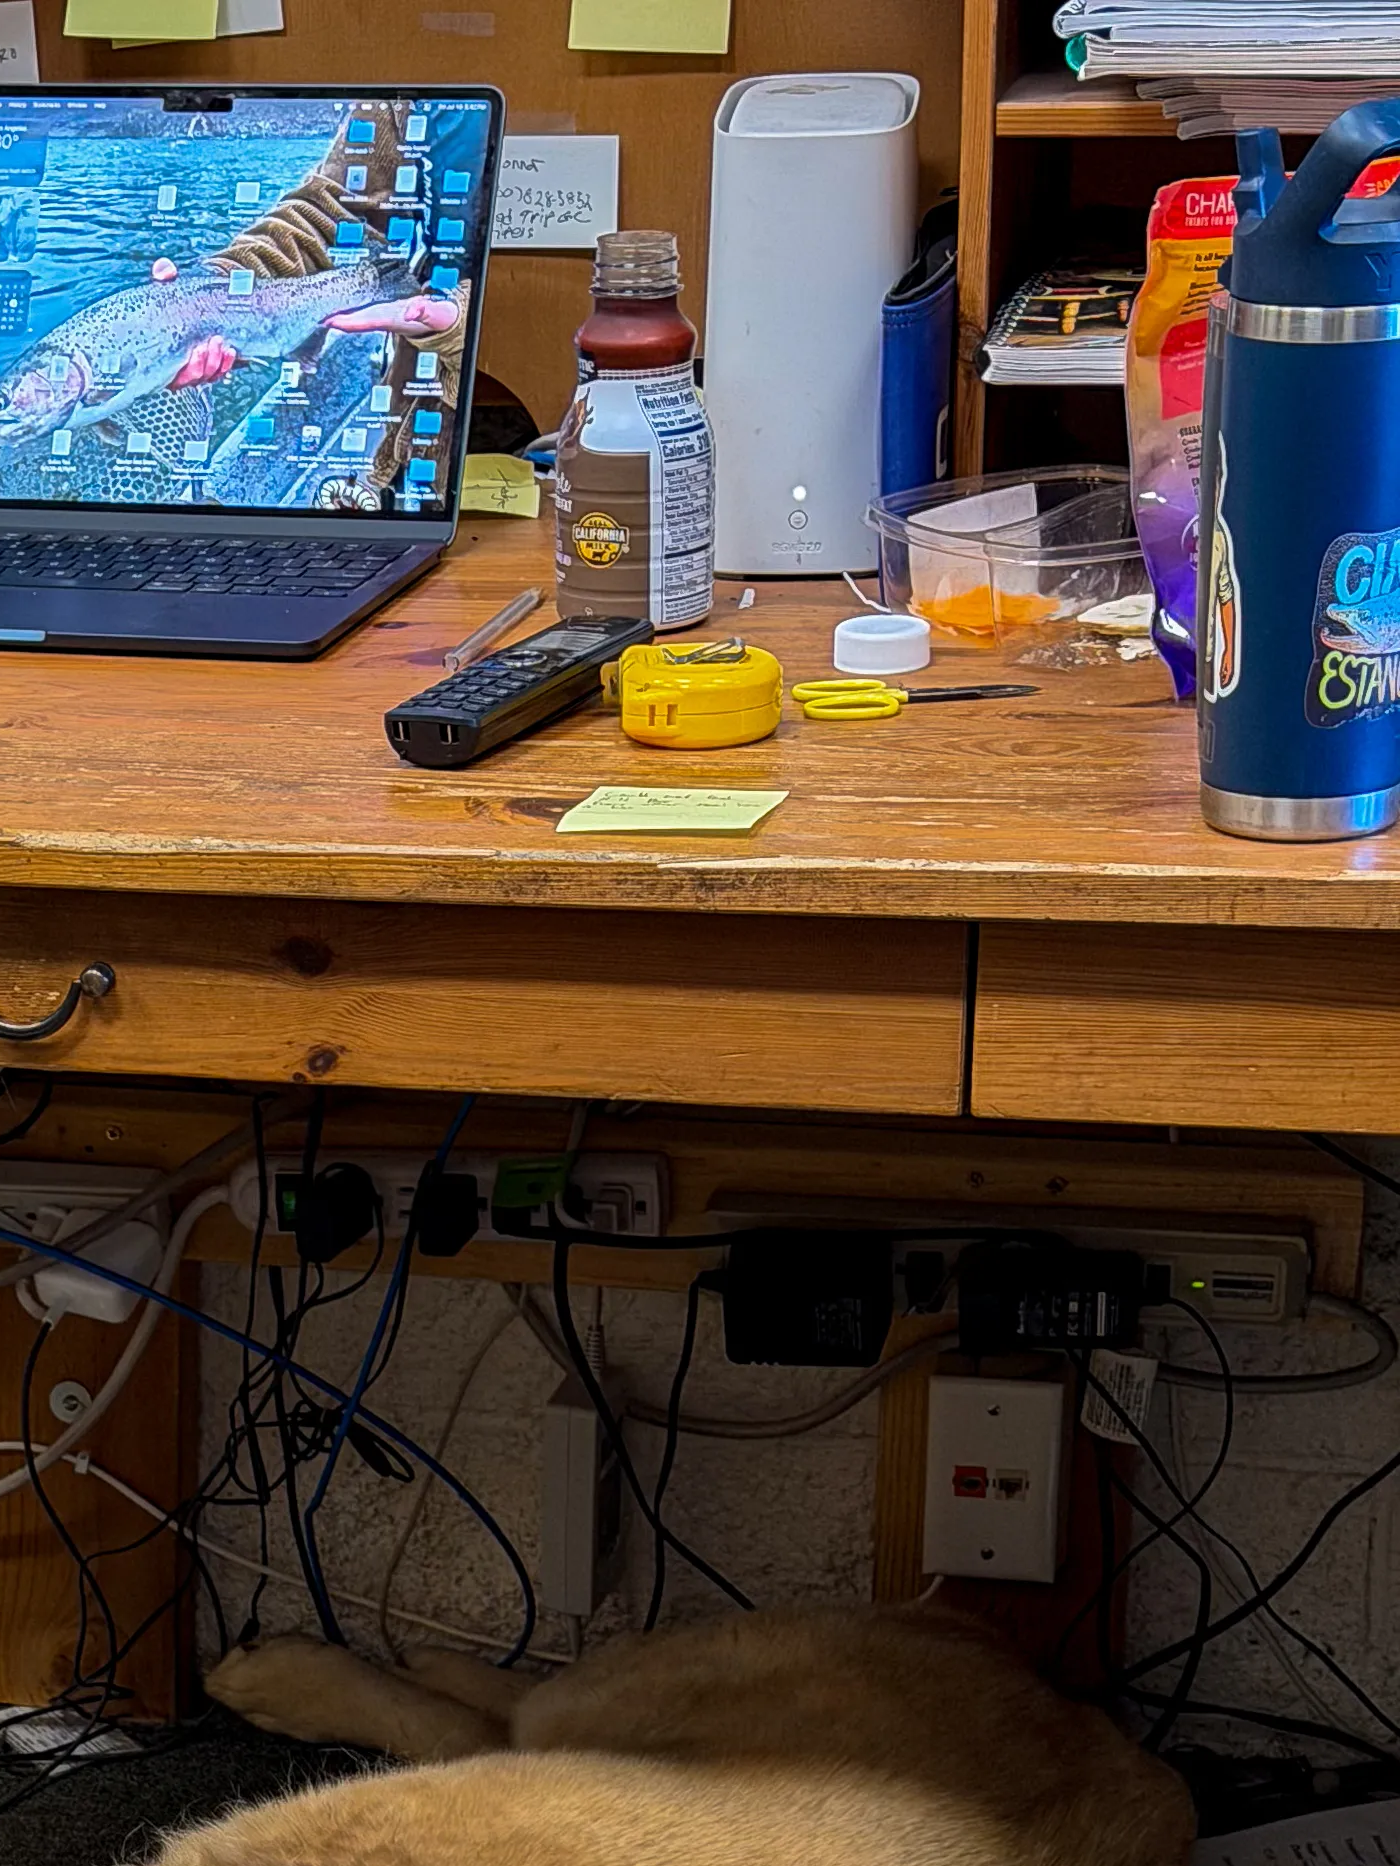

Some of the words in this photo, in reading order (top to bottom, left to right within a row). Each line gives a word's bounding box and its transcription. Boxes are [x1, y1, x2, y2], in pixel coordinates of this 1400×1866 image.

[519, 208, 556, 228] Trip
[1184, 216, 1210, 227] TREATS
[1210, 215, 1224, 226] FOR
[641, 395, 680, 410] Nutrition
[662, 442, 696, 458] Calories
[574, 527, 626, 543] CALIFORNIA
[585, 542, 611, 551] MILK
[1318, 650, 1400, 709] ESTAN
